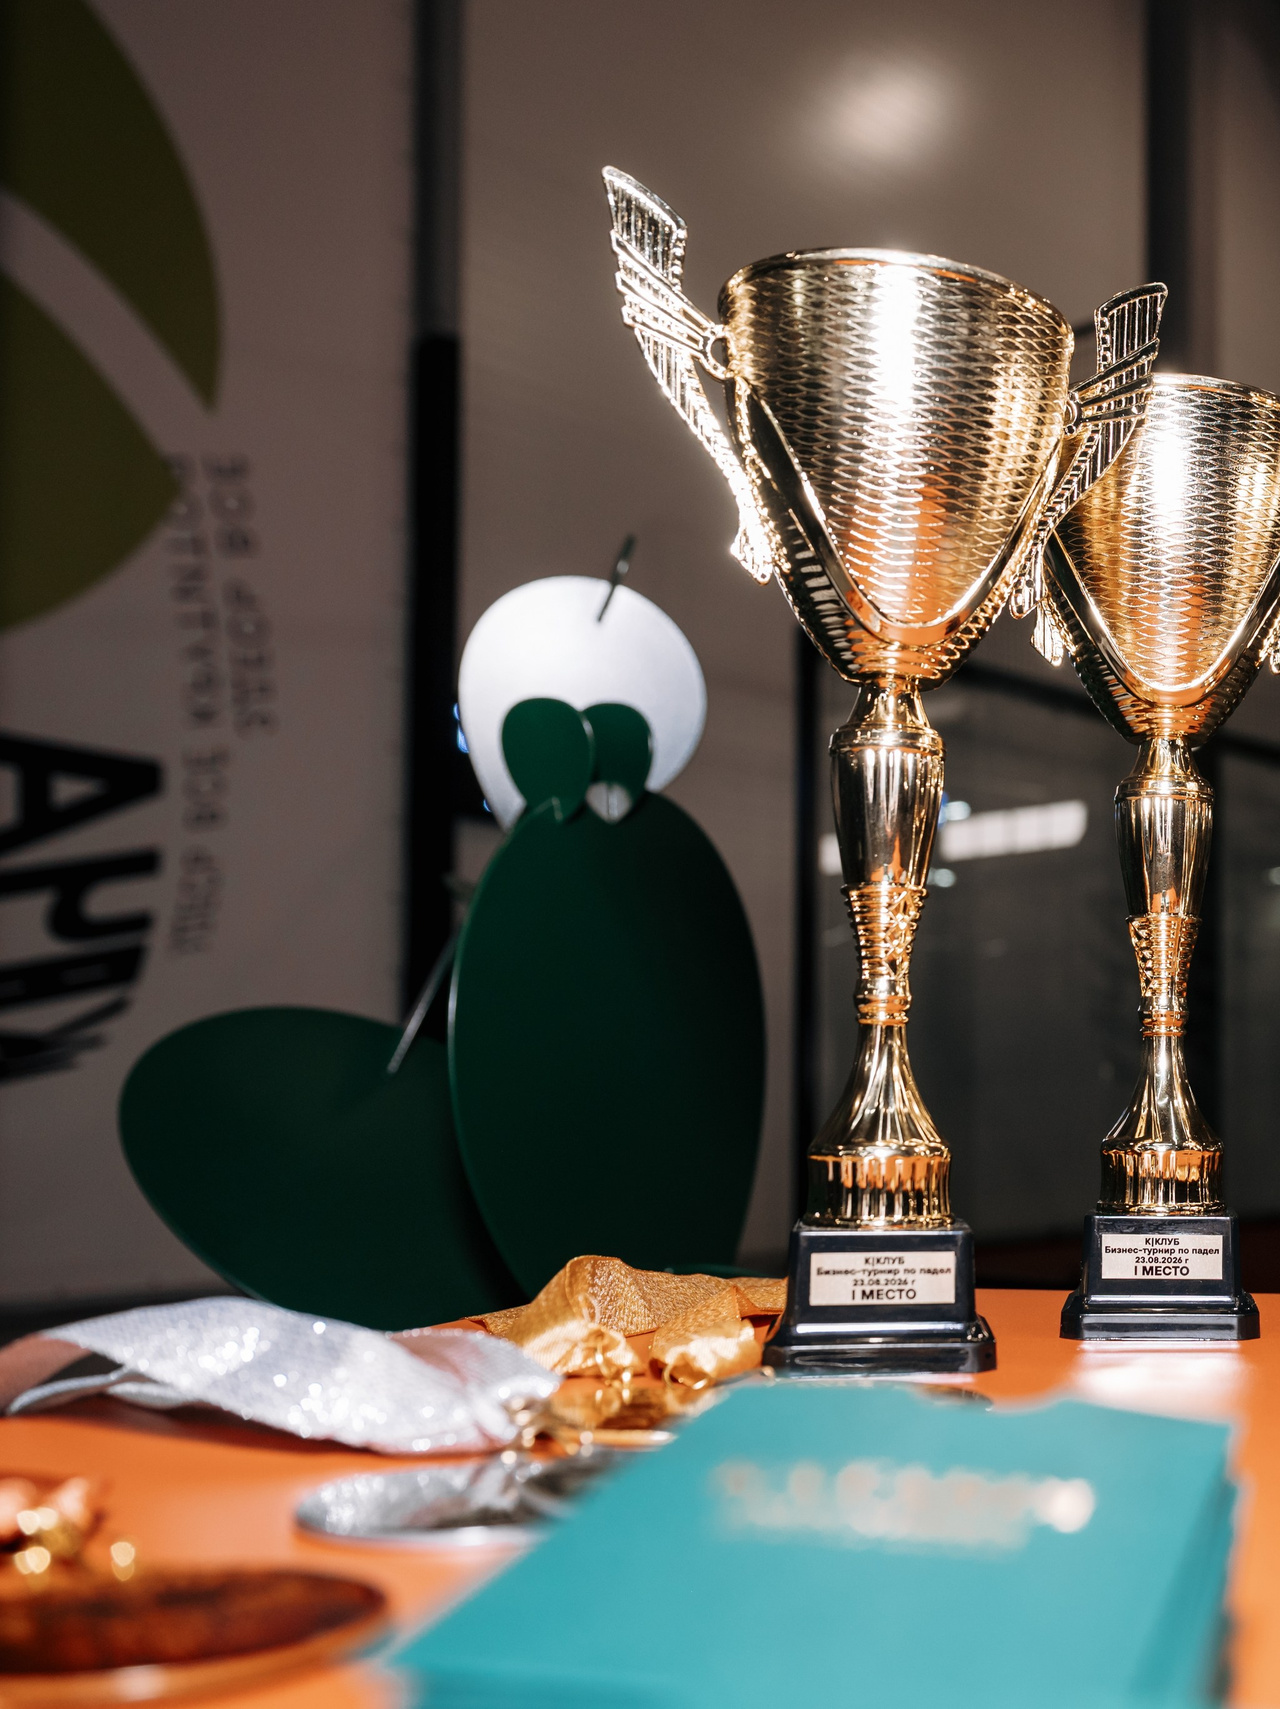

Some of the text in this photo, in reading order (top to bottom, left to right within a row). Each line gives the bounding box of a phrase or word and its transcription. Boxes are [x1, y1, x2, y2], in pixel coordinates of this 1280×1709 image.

[1105, 1246, 1175, 1255] Бизнес-турнир
[817, 1268, 899, 1277] Бизнес-турнир
[920, 1268, 951, 1276] падел
[1142, 1266, 1190, 1276] МЕСТО
[862, 1289, 917, 1300] МЕСТО
